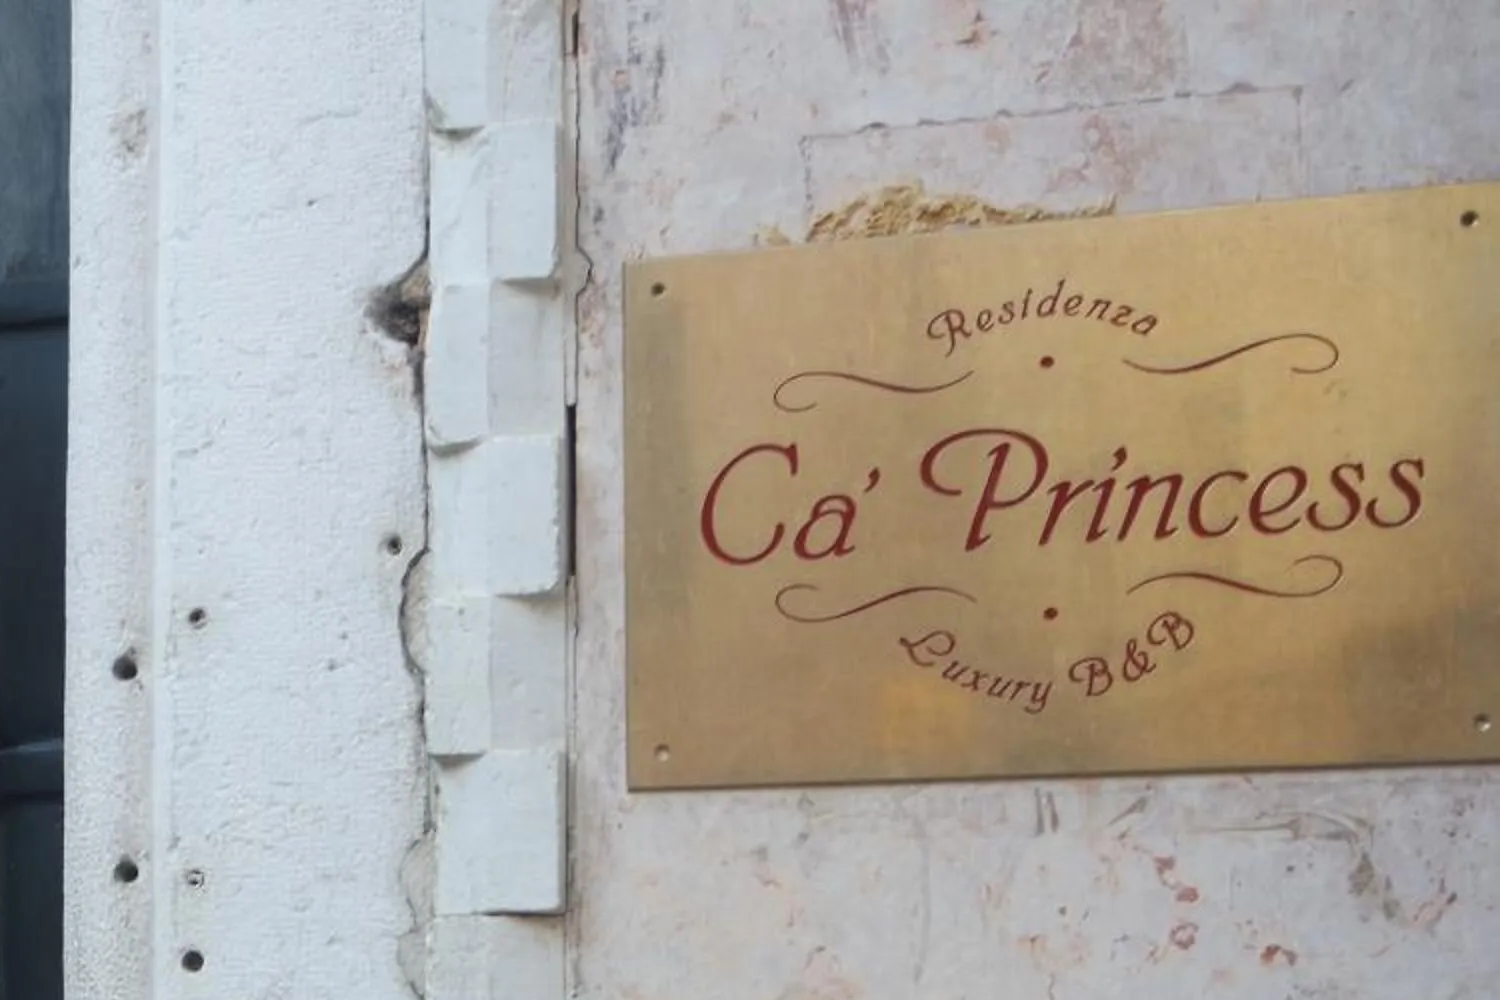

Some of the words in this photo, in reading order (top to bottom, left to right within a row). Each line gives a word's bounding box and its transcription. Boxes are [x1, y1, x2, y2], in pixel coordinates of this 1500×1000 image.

[926, 278, 1158, 357] Residenza
[700, 442, 881, 566] Ca'
[919, 428, 1426, 553] Princess
[898, 629, 1053, 715] Luxury
[1068, 611, 1195, 697] B&B
